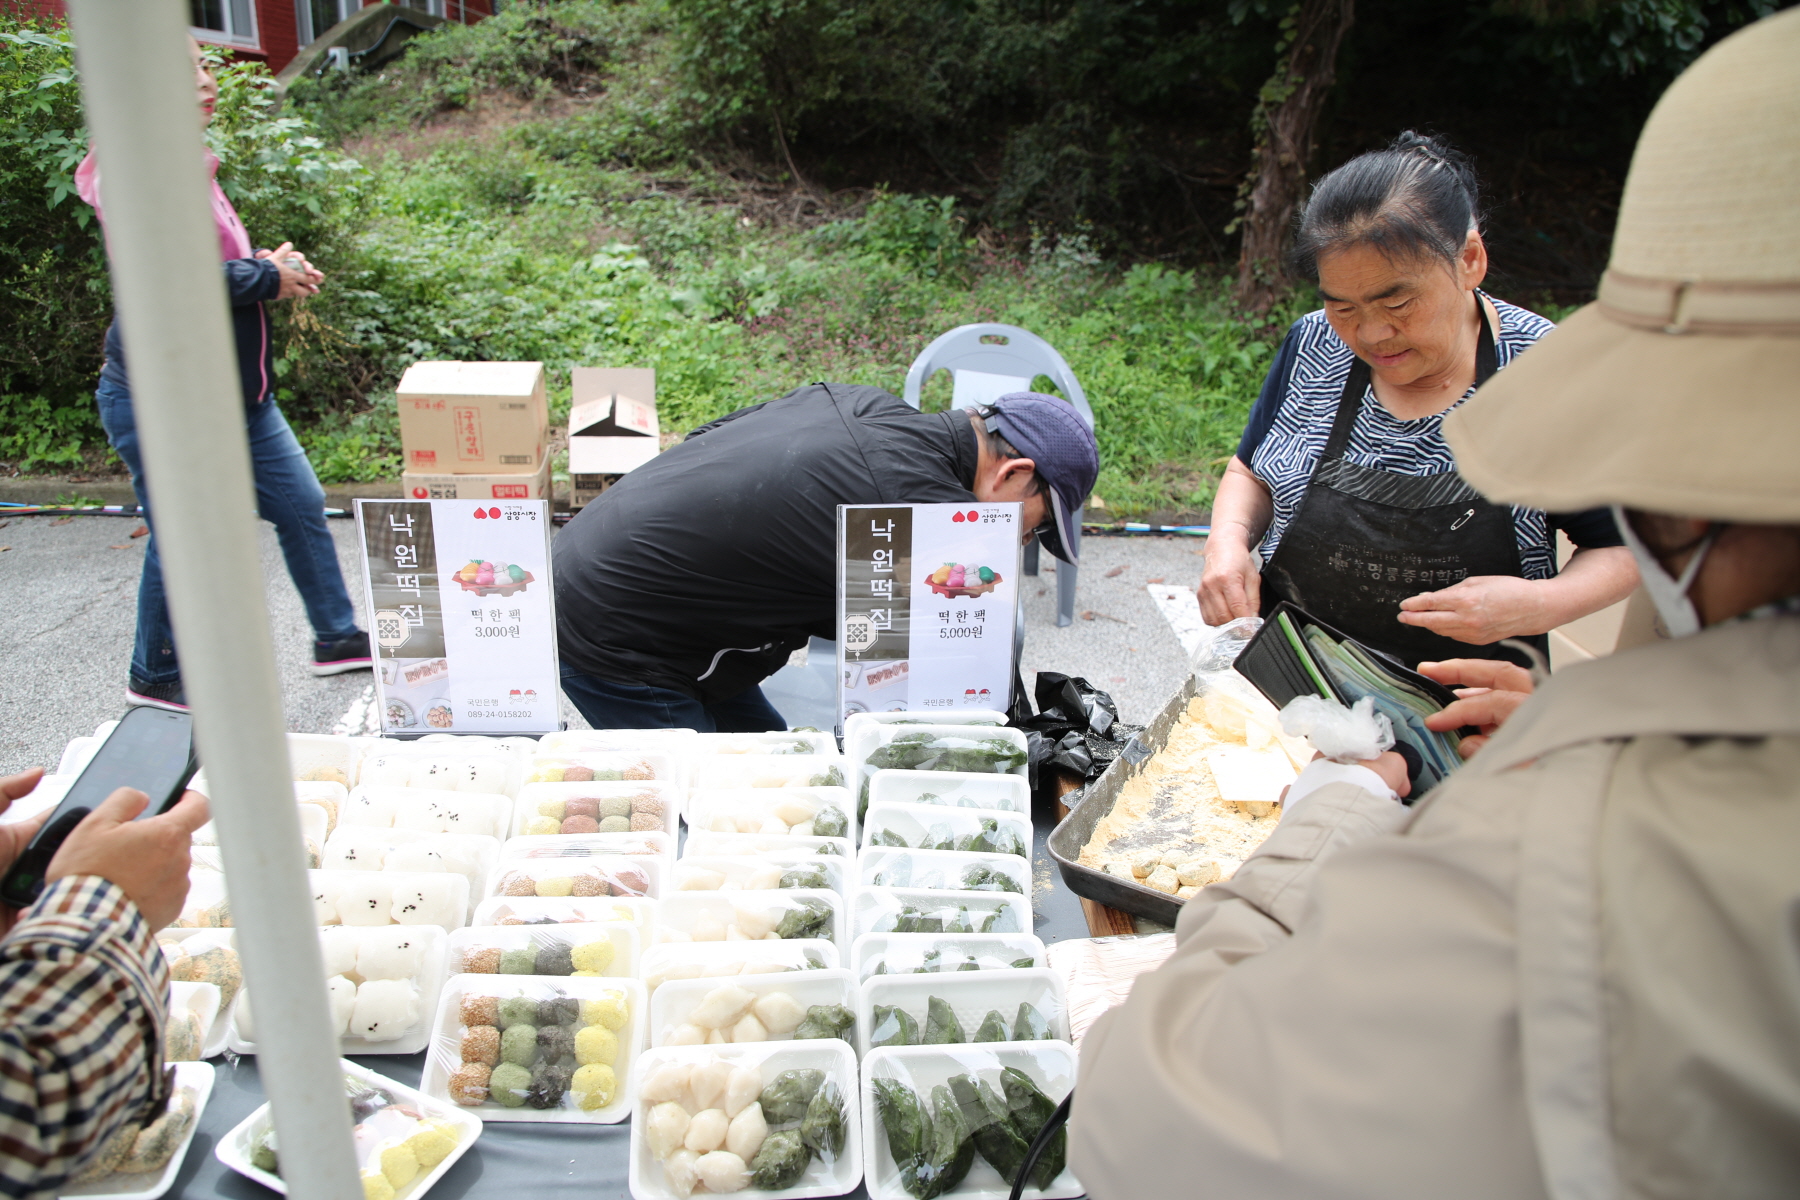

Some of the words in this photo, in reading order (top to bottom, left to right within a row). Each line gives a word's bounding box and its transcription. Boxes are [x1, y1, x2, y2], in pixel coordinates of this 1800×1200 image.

[504, 511, 537, 521] 삼양시장
[981, 513, 1012, 523] 삼양시장
[389, 513, 424, 627] 낙원떡집
[870, 518, 896, 631] 낙원떡집
[471, 608, 484, 622] 떡
[489, 608, 503, 622] 한
[508, 608, 522, 622] 팩
[938, 610, 950, 624] 떡
[955, 609, 969, 623] 한
[973, 609, 986, 623] 팩
[475, 625, 520, 639] 3,000원
[939, 626, 983, 640] 5,000원
[467, 698, 499, 707] 국민은행
[922, 698, 954, 707] 국민은행
[467, 710, 533, 719] 089-24-0158202
